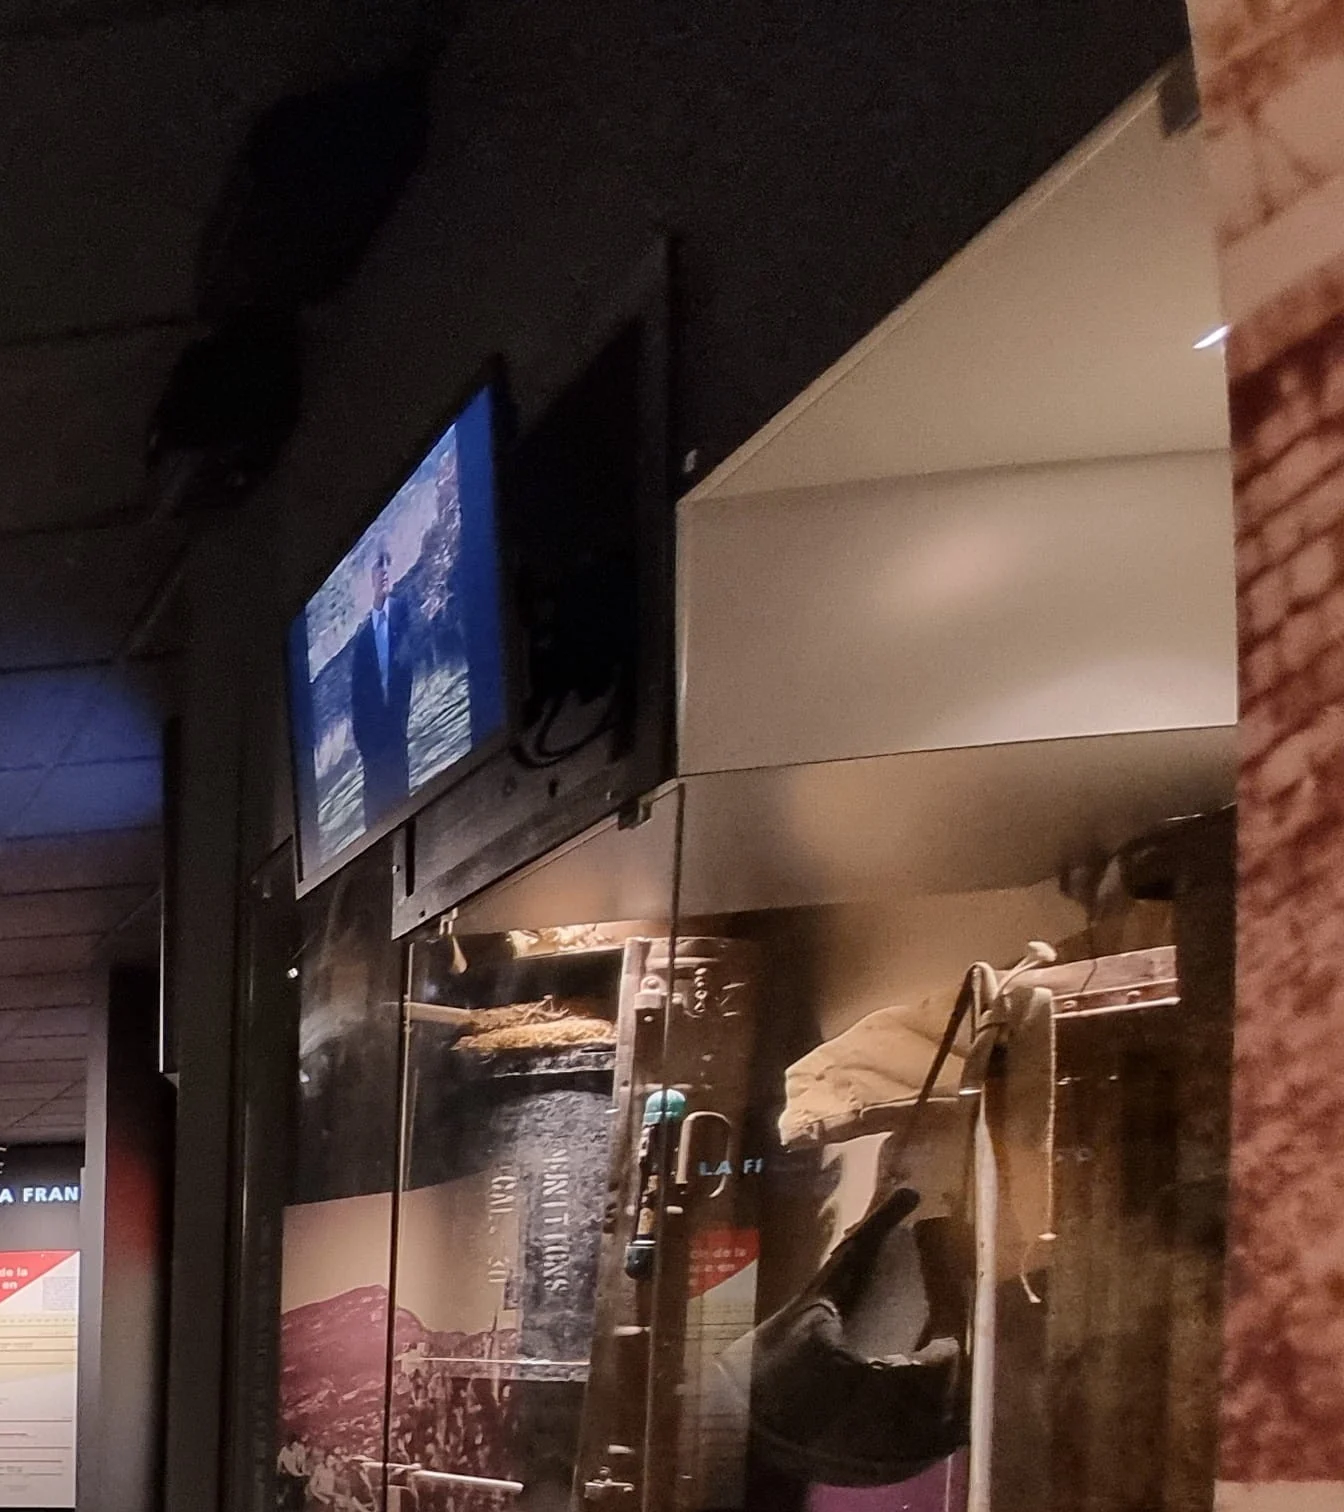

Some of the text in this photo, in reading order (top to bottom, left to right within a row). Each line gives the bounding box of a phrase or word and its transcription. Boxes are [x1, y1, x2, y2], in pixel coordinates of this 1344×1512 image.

[23, 1186, 79, 1202] FRAN
[17, 1267, 28, 1277] la
[2, 1281, 18, 1289] en
